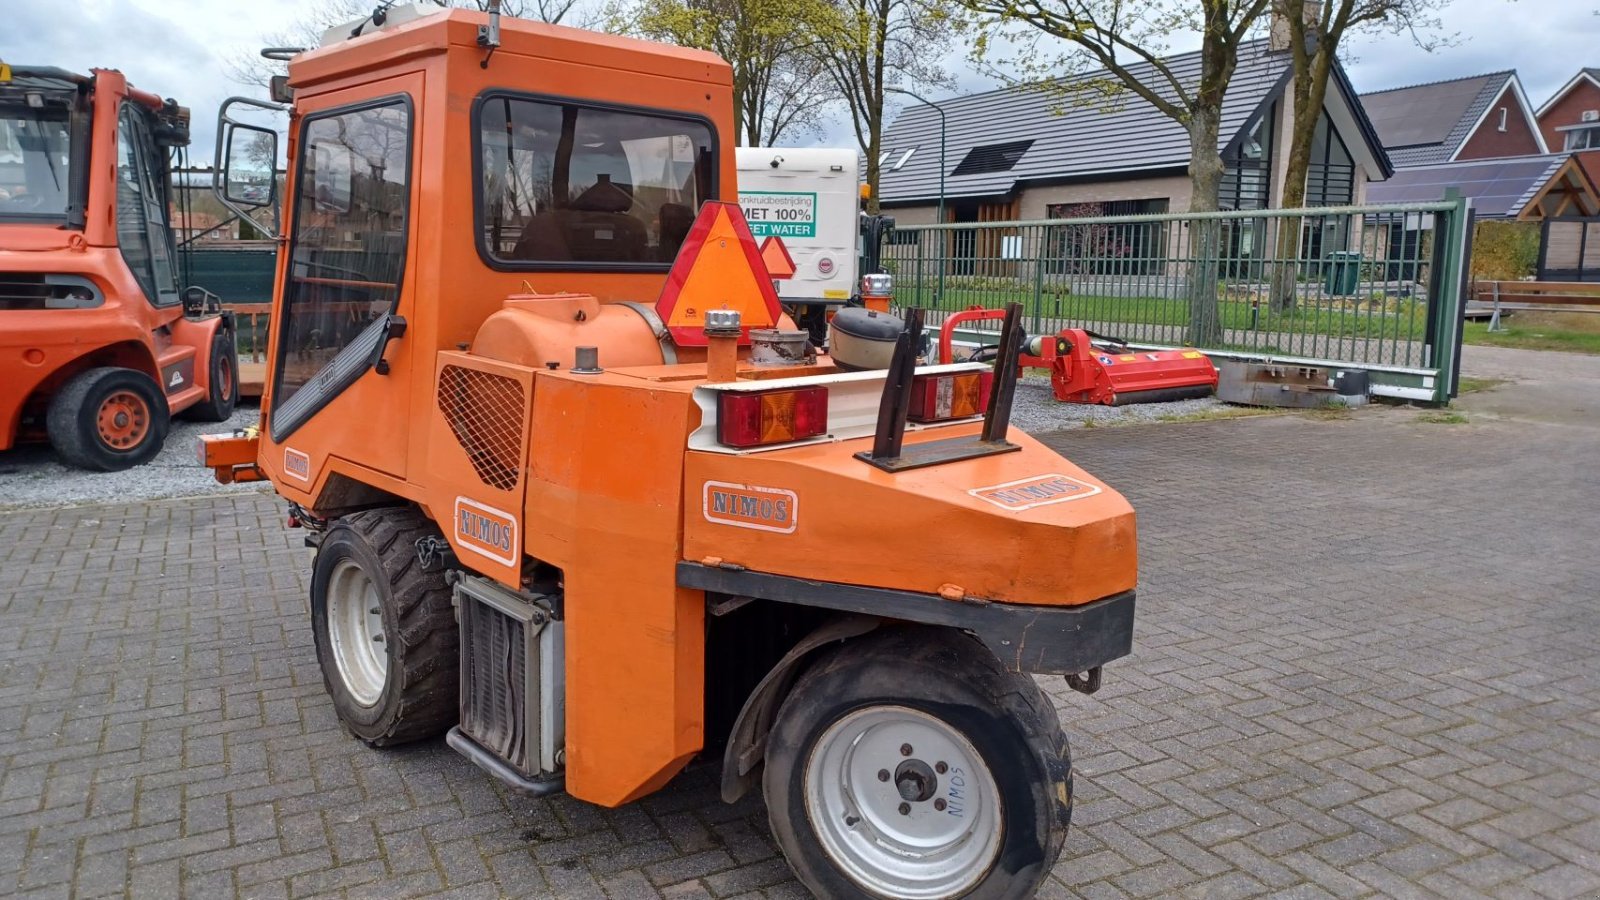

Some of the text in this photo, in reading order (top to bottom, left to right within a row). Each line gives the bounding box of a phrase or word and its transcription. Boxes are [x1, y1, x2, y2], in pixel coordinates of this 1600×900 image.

[775, 209, 811, 220] 100%
[771, 224, 810, 234] WATER
[989, 479, 1078, 503] NIMOS
[713, 491, 787, 522] NIMOS
[461, 509, 510, 551] NIMOS
[948, 767, 965, 818] NIMOS
